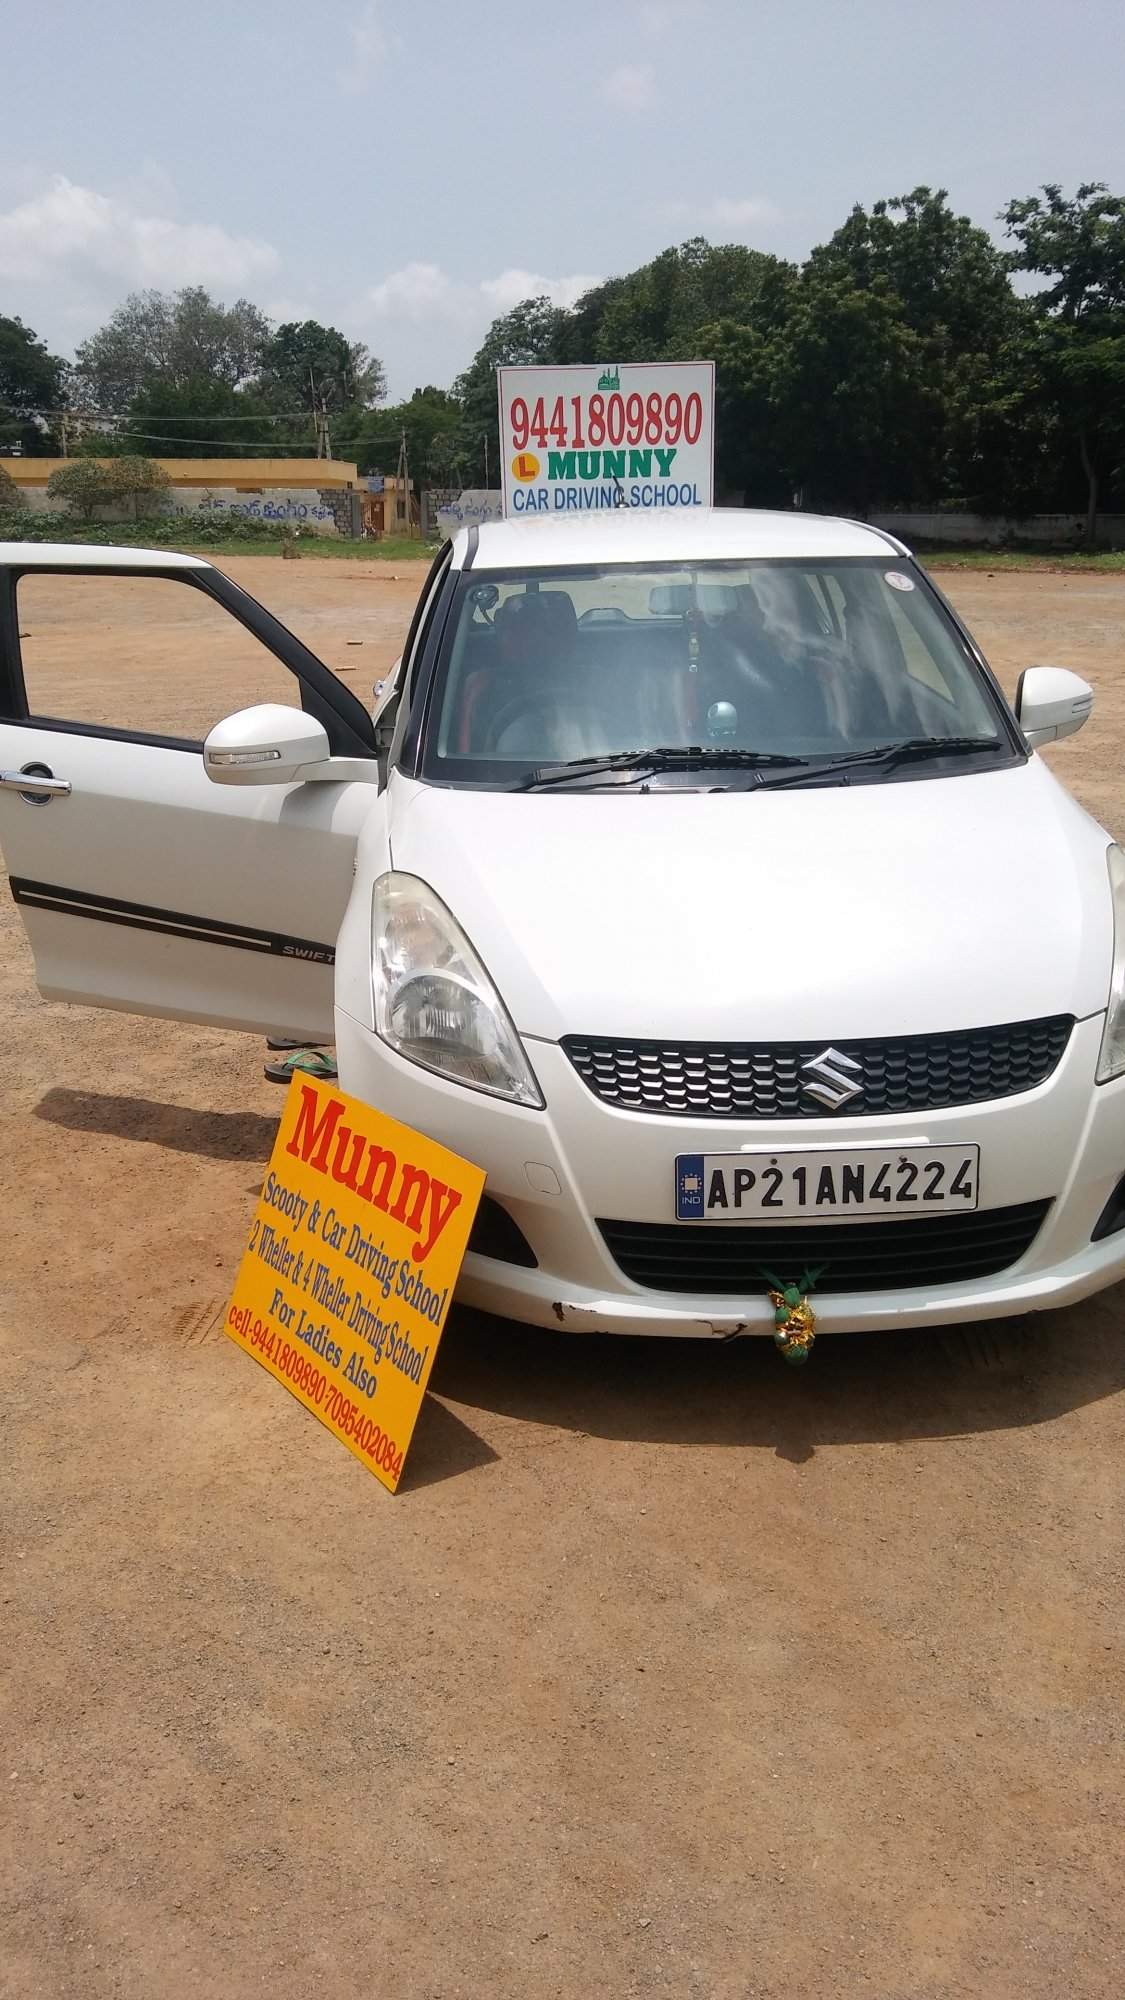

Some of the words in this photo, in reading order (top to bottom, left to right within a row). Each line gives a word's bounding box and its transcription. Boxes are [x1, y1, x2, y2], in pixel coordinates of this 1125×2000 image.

[510, 392, 703, 450] 9441809890
[518, 456, 535, 478] L
[547, 449, 677, 481] MUNNY
[513, 488, 548, 511] CAR
[630, 483, 702, 508] SCHOOL
[282, 945, 335, 962] SWIFT
[286, 1084, 463, 1264] Munny
[681, 1196, 701, 1205] IND
[707, 1158, 973, 1209] AP21AN4224
[263, 1171, 308, 1233] Scooty
[307, 1199, 321, 1234] &
[321, 1208, 347, 1251] Car
[345, 1223, 399, 1299] Driving
[395, 1259, 449, 1328] School
[248, 1219, 260, 1252] 2
[257, 1224, 296, 1279] Wheller
[291, 1251, 304, 1286] &
[303, 1258, 315, 1292] 4
[311, 1262, 351, 1322] Wheller
[347, 1291, 391, 1366] Driving
[385, 1320, 430, 1386] School
[268, 1288, 296, 1329] For
[295, 1309, 343, 1369] Ladies
[342, 1351, 377, 1399] Also
